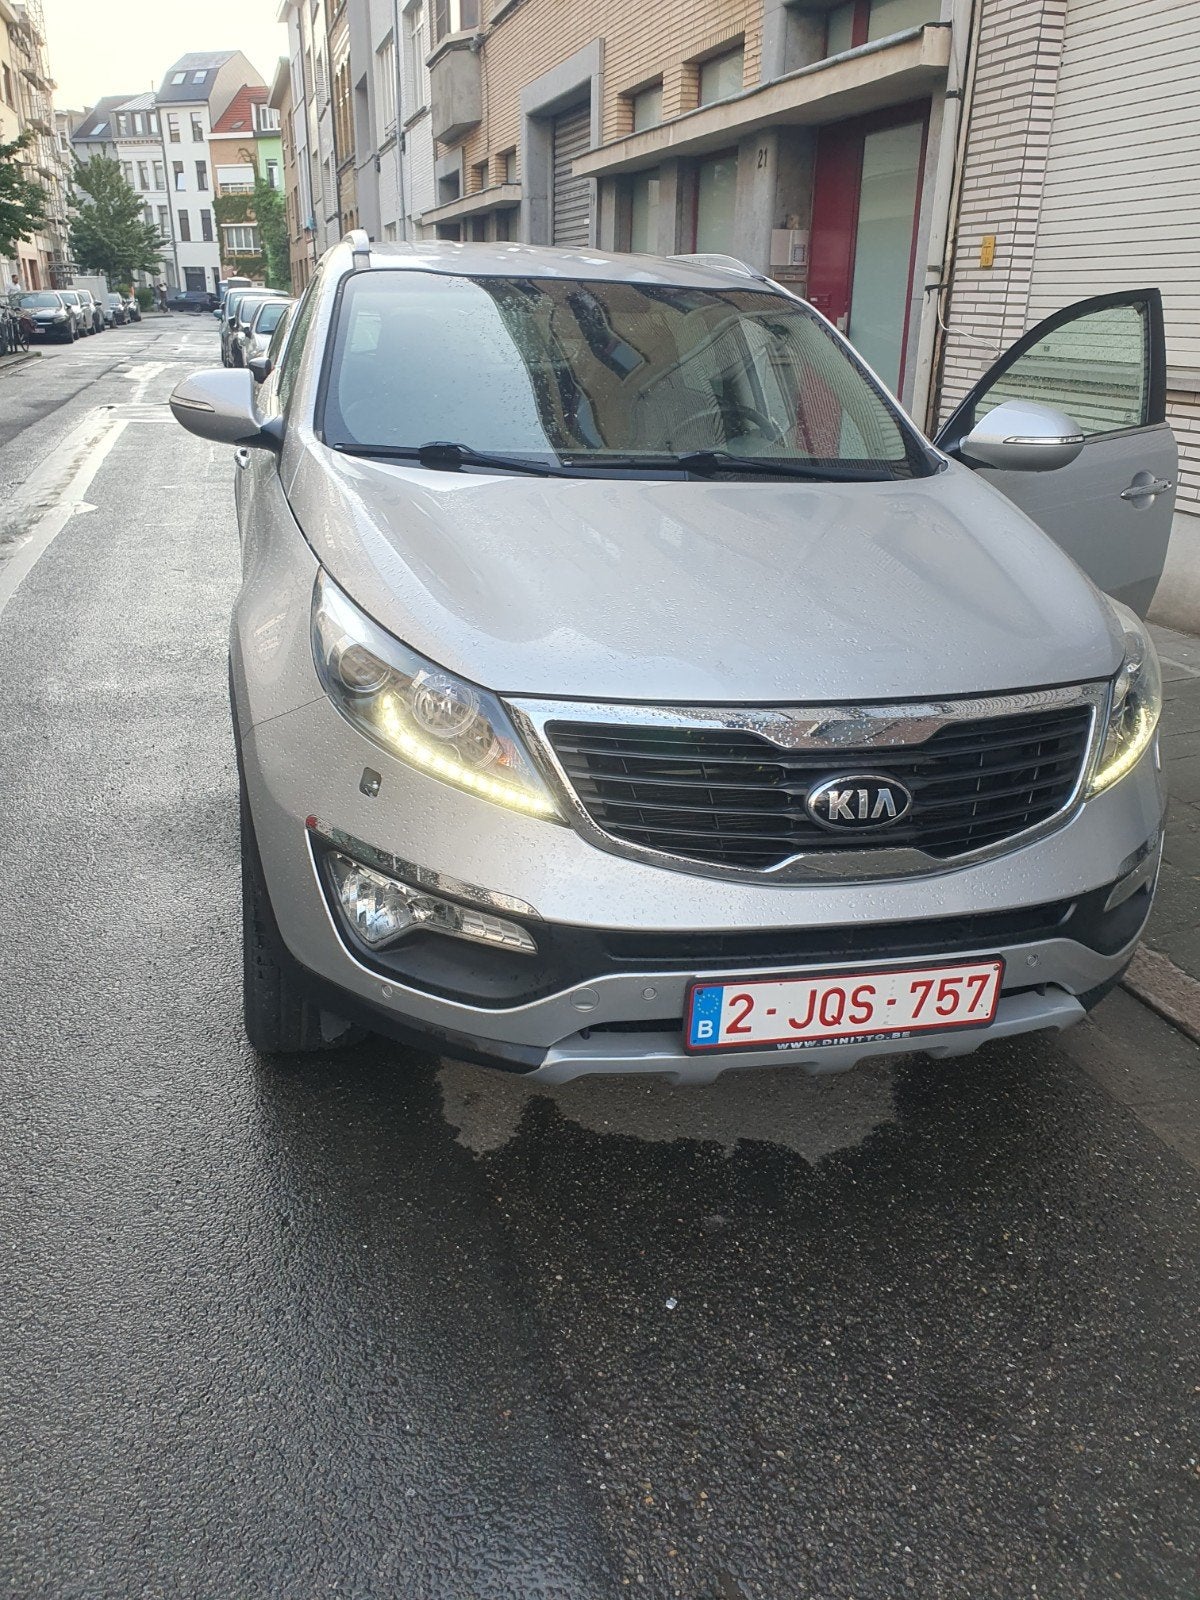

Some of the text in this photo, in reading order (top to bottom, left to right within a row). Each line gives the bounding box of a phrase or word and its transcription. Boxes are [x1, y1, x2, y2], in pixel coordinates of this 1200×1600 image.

[757, 147, 768, 169] 21
[827, 788, 897, 820] KIA
[697, 1019, 714, 1039] B
[776, 1031, 911, 1050] WWW.DINITTO.BE
